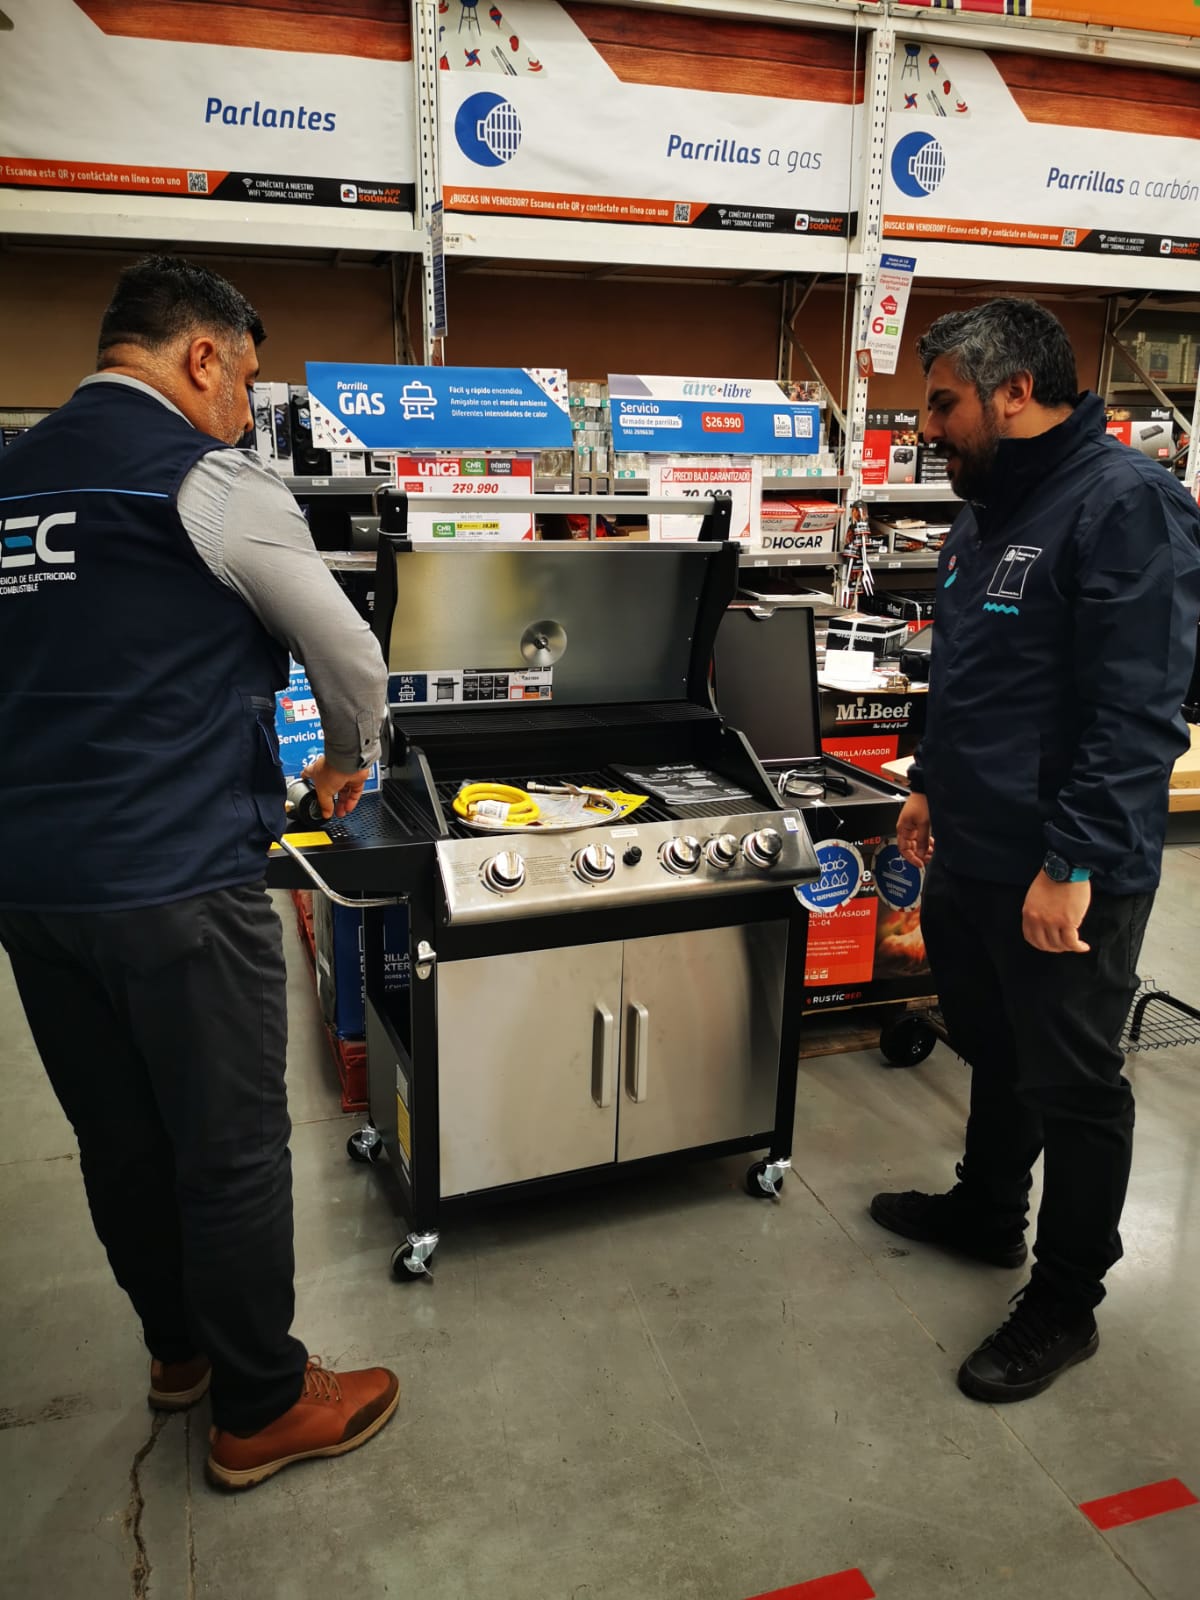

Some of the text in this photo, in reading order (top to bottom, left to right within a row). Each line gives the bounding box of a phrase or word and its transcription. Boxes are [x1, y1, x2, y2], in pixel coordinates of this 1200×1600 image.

[205, 97, 336, 132] Parlantes
[666, 134, 822, 173] Parrillas a gas
[6, 166, 37, 177] Escanea
[39, 169, 56, 178] este
[58, 169, 69, 180] QR
[70, 172, 76, 182] y
[77, 171, 119, 182] contáctate
[120, 175, 130, 183] en
[131, 173, 150, 184] línea
[151, 176, 165, 185] con
[166, 177, 181, 186] uno
[256, 179, 285, 189] CONÉCTATE
[290, 182, 314, 191] NUESTRO
[1046, 167, 1199, 201] Parrillas a carbón
[248, 189, 261, 197] WIFI
[358, 194, 400, 204] SODIMAC
[450, 194, 669, 216] ¿BUSCAS UN VENDEDOR? Escanea este QR y contáctate en línea con uno
[809, 223, 841, 232] SODIMAC
[906, 222, 915, 231] UN
[915, 223, 946, 233] VENDEDOR?
[947, 225, 968, 234] Escanea
[968, 227, 979, 235] este
[980, 227, 988, 236] QR
[988, 229, 992, 237] y
[992, 228, 1019, 238] contáctate
[1020, 231, 1027, 239] en
[1040, 232, 1049, 240] con
[1049, 233, 1059, 241] uno
[872, 316, 885, 334] 6
[337, 381, 368, 391] Parrilla
[449, 386, 464, 394] Fácil
[471, 387, 490, 395] rápido
[492, 387, 523, 395] encendido
[683, 381, 752, 399] aire libre
[339, 392, 385, 416] GAS
[450, 398, 479, 407] Amigable
[620, 401, 660, 414] Servicio
[451, 409, 548, 418] Diferentes intensidades de calor
[705, 416, 741, 429] $26.990
[465, 461, 481, 469] CMR
[491, 461, 510, 469] DÉBITO
[673, 471, 751, 481] PRECIO BAJO GARANTIZADO
[452, 483, 499, 494] 279.990
[0, 511, 77, 568] EC
[761, 535, 823, 549] DHOGAR
[19, 575, 28, 583] DE
[28, 572, 77, 582] ELECTRICIDAD
[0, 583, 39, 595] COMBUSTIBLE
[401, 676, 414, 684] GAS
[836, 702, 912, 720] Mr.Beef
[278, 731, 316, 745] Servicio
